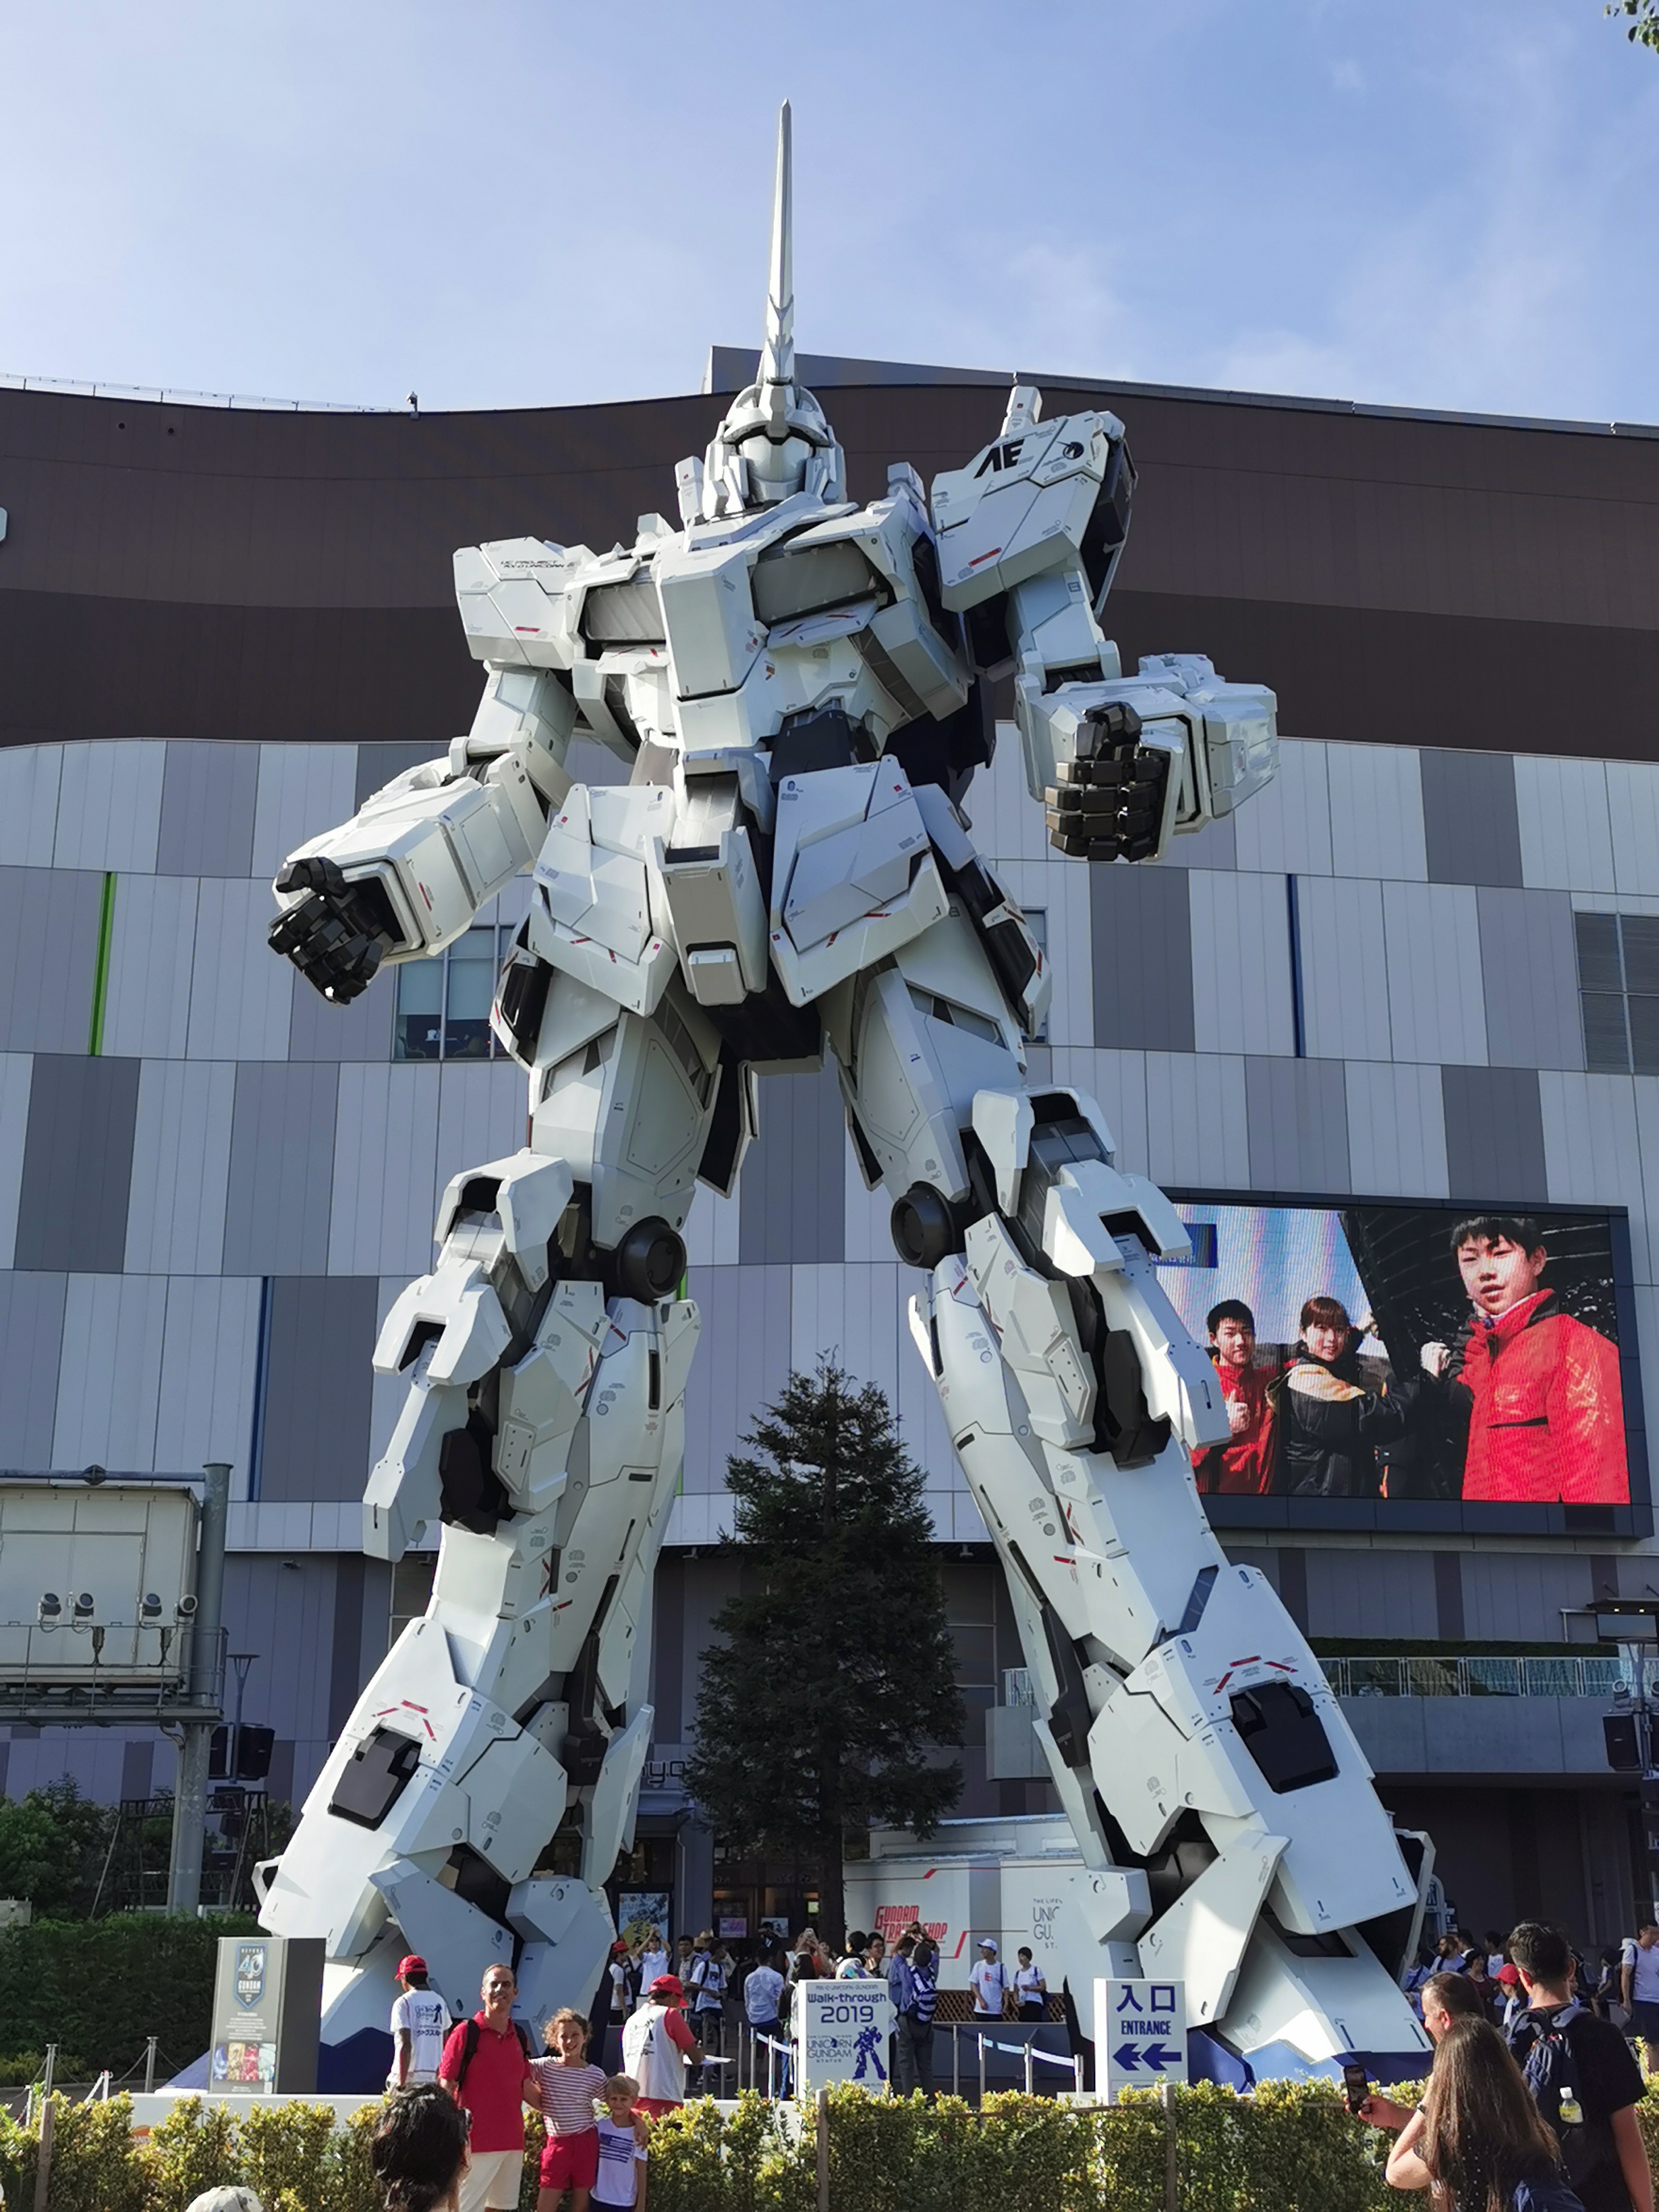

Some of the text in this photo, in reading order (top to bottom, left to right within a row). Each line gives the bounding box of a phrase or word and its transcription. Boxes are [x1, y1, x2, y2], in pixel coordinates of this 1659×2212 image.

[874, 1905, 919, 1929] GUNDAM
[807, 1992, 887, 2003] Walk-through
[1116, 1985, 1176, 2013] 入口
[820, 2005, 874, 2023] 2019
[1121, 2020, 1171, 2035] ENTRANCE
[806, 2049, 853, 2059] GUNDAM
